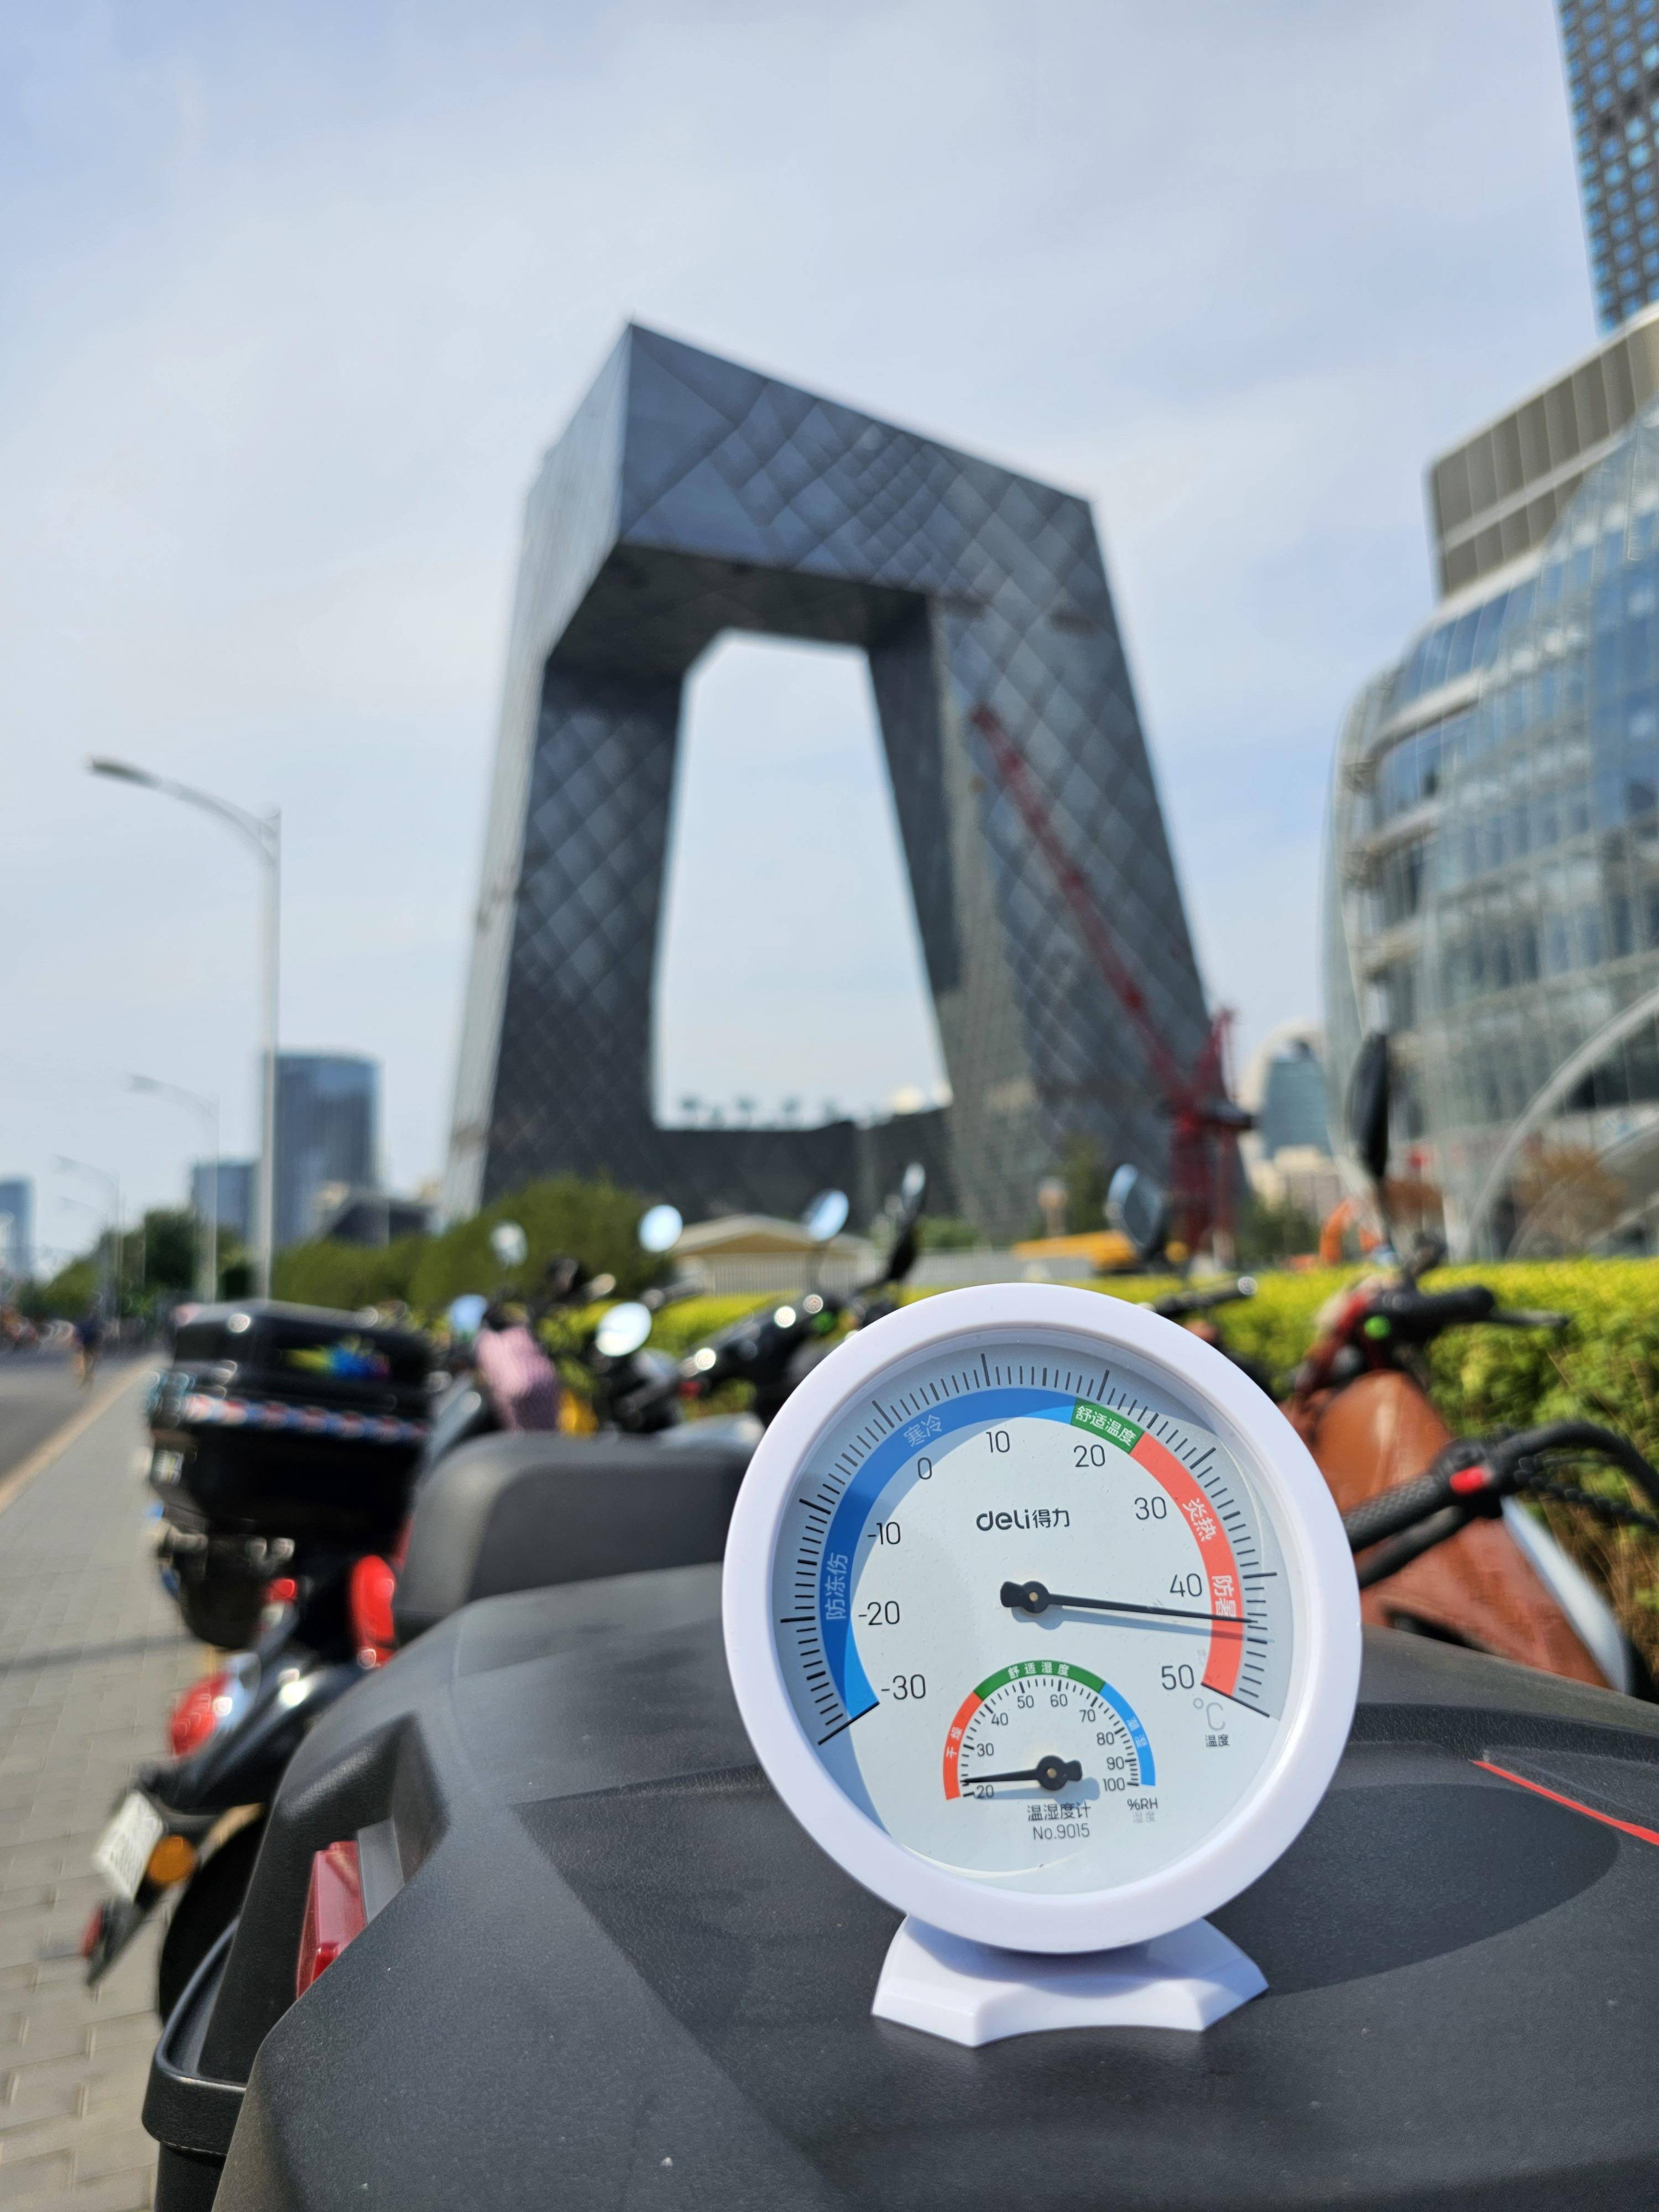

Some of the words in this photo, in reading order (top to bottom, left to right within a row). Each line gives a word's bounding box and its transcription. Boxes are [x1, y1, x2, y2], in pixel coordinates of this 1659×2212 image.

[903, 1413, 943, 1447] 寒冷
[1075, 1406, 1138, 1446] 舒适温度
[985, 1430, 1010, 1453] 10
[1073, 1444, 1106, 1468] 20
[917, 1457, 933, 1480] 0
[1134, 1496, 1167, 1520] 30
[1182, 1498, 1216, 1542] 炎热
[867, 1521, 901, 1545] -10
[824, 1552, 848, 1620] 防冻伤
[1170, 1573, 1202, 1597] 40
[858, 1600, 901, 1626] -20
[1007, 1661, 1070, 1679] 舒适湿度
[1161, 1664, 1194, 1691] 50
[880, 1673, 926, 1700] -30
[1016, 1694, 1035, 1709] 50
[1050, 1693, 1068, 1708] 60
[990, 1712, 1009, 1726] 40
[1078, 1709, 1097, 1723] 70
[1096, 1731, 1115, 1746] 80
[1204, 1733, 1230, 1747] 温度
[976, 1742, 995, 1757] 30
[1107, 1756, 1125, 1771] 90
[976, 1784, 995, 1799] 20
[1102, 1777, 1126, 1792] 100
[1026, 1801, 1092, 1822] 温湿度计
[1126, 1797, 1159, 1810] %RH
[1032, 1822, 1091, 1841] No.9015
